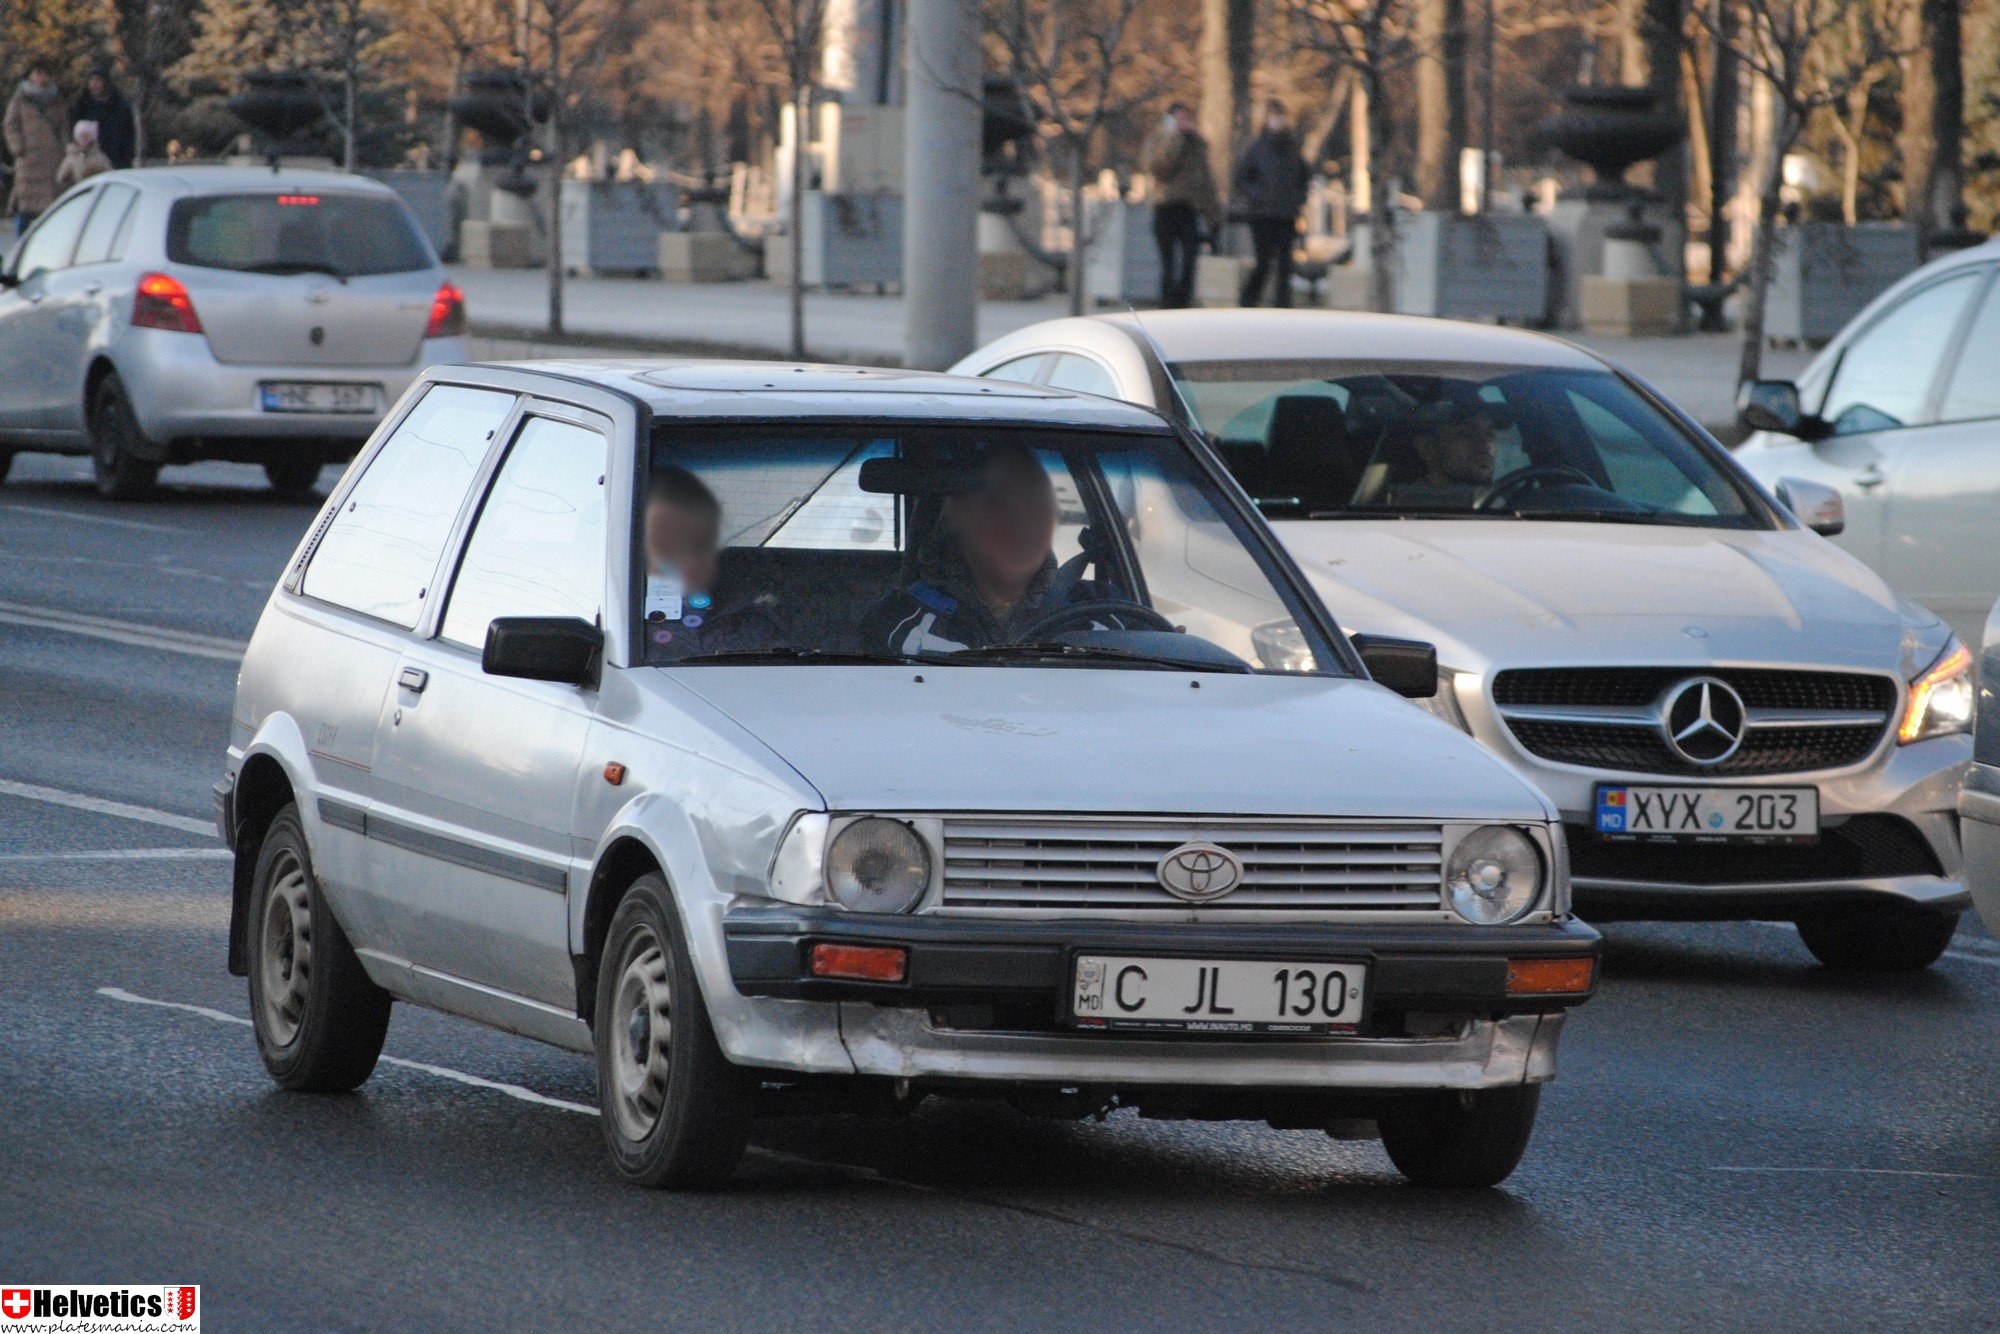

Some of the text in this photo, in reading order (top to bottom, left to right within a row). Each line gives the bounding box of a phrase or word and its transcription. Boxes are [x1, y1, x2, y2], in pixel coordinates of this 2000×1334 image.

[1601, 814, 1622, 828] MD
[1632, 793, 1797, 830] XYX 203
[1078, 994, 1100, 1011] MD
[1115, 965, 1347, 1017] C JL 130
